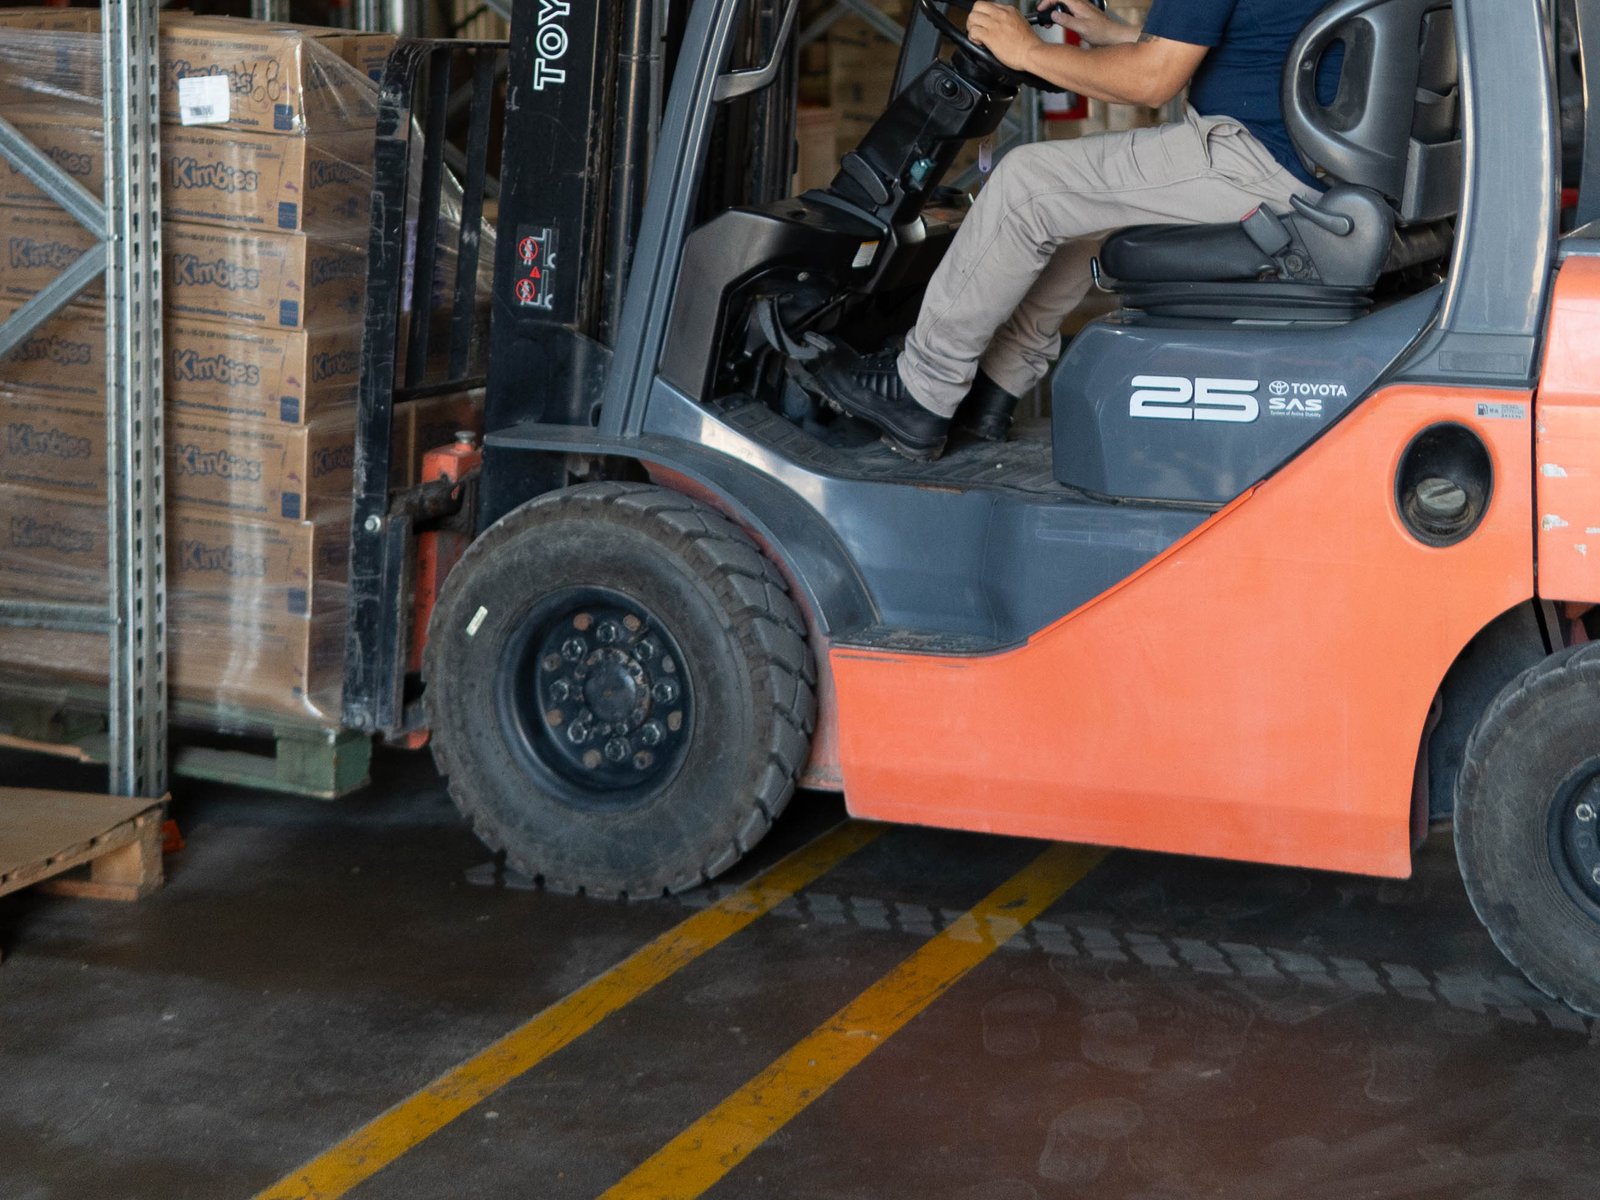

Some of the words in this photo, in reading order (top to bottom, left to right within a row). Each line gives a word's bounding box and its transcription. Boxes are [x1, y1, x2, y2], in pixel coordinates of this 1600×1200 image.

[170, 156, 258, 193] Kimbies
[173, 253, 260, 290] Kimbies
[172, 348, 260, 386] Kimbies
[1129, 375, 1259, 422] 25
[1268, 397, 1322, 411] SAS
[1291, 382, 1348, 398] TOYOTA
[173, 444, 262, 481] Kimbies
